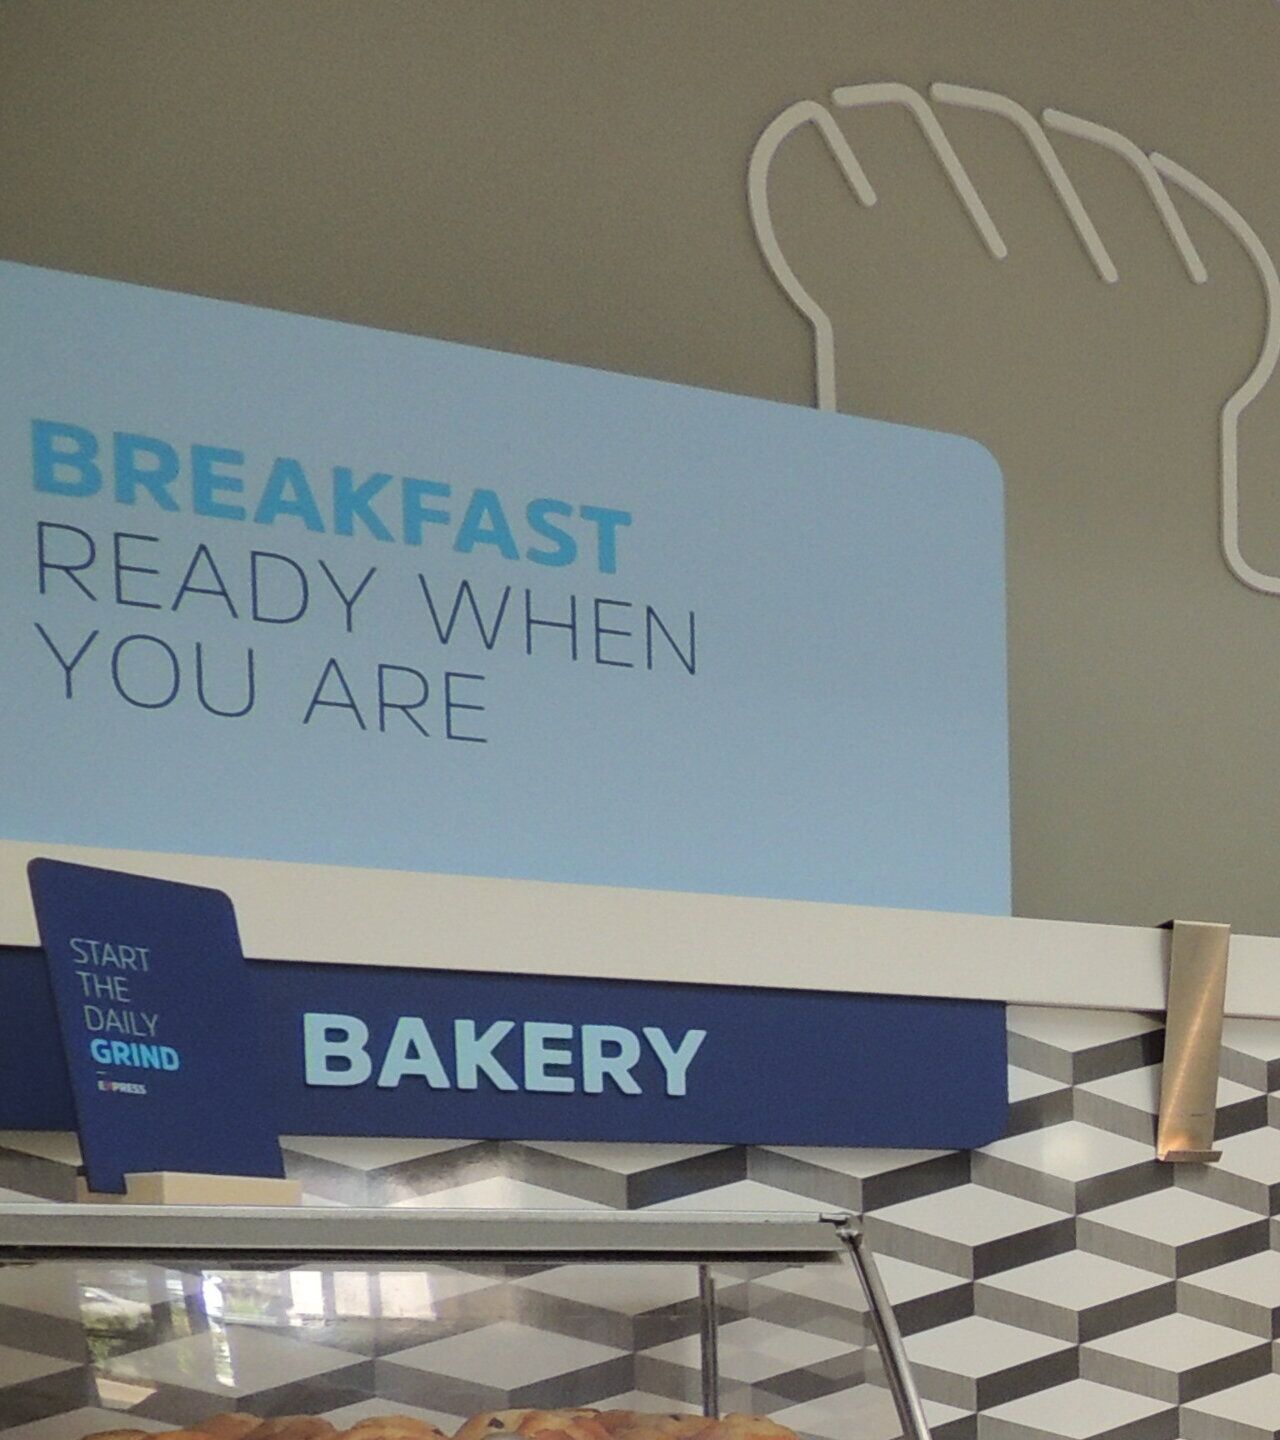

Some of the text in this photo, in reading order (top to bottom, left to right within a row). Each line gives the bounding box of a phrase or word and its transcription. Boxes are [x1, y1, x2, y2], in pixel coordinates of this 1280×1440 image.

[30, 417, 633, 574] BREAKFAST
[37, 520, 696, 676] READY WHEN
[34, 621, 488, 743] YOU ARE
[70, 938, 150, 972] START
[75, 971, 131, 1003] THE
[84, 1005, 159, 1037] DAILY
[90, 1038, 180, 1071] GRIND
[303, 1012, 707, 1097] BAKERY
[98, 1080, 147, 1094] EXPRESS
